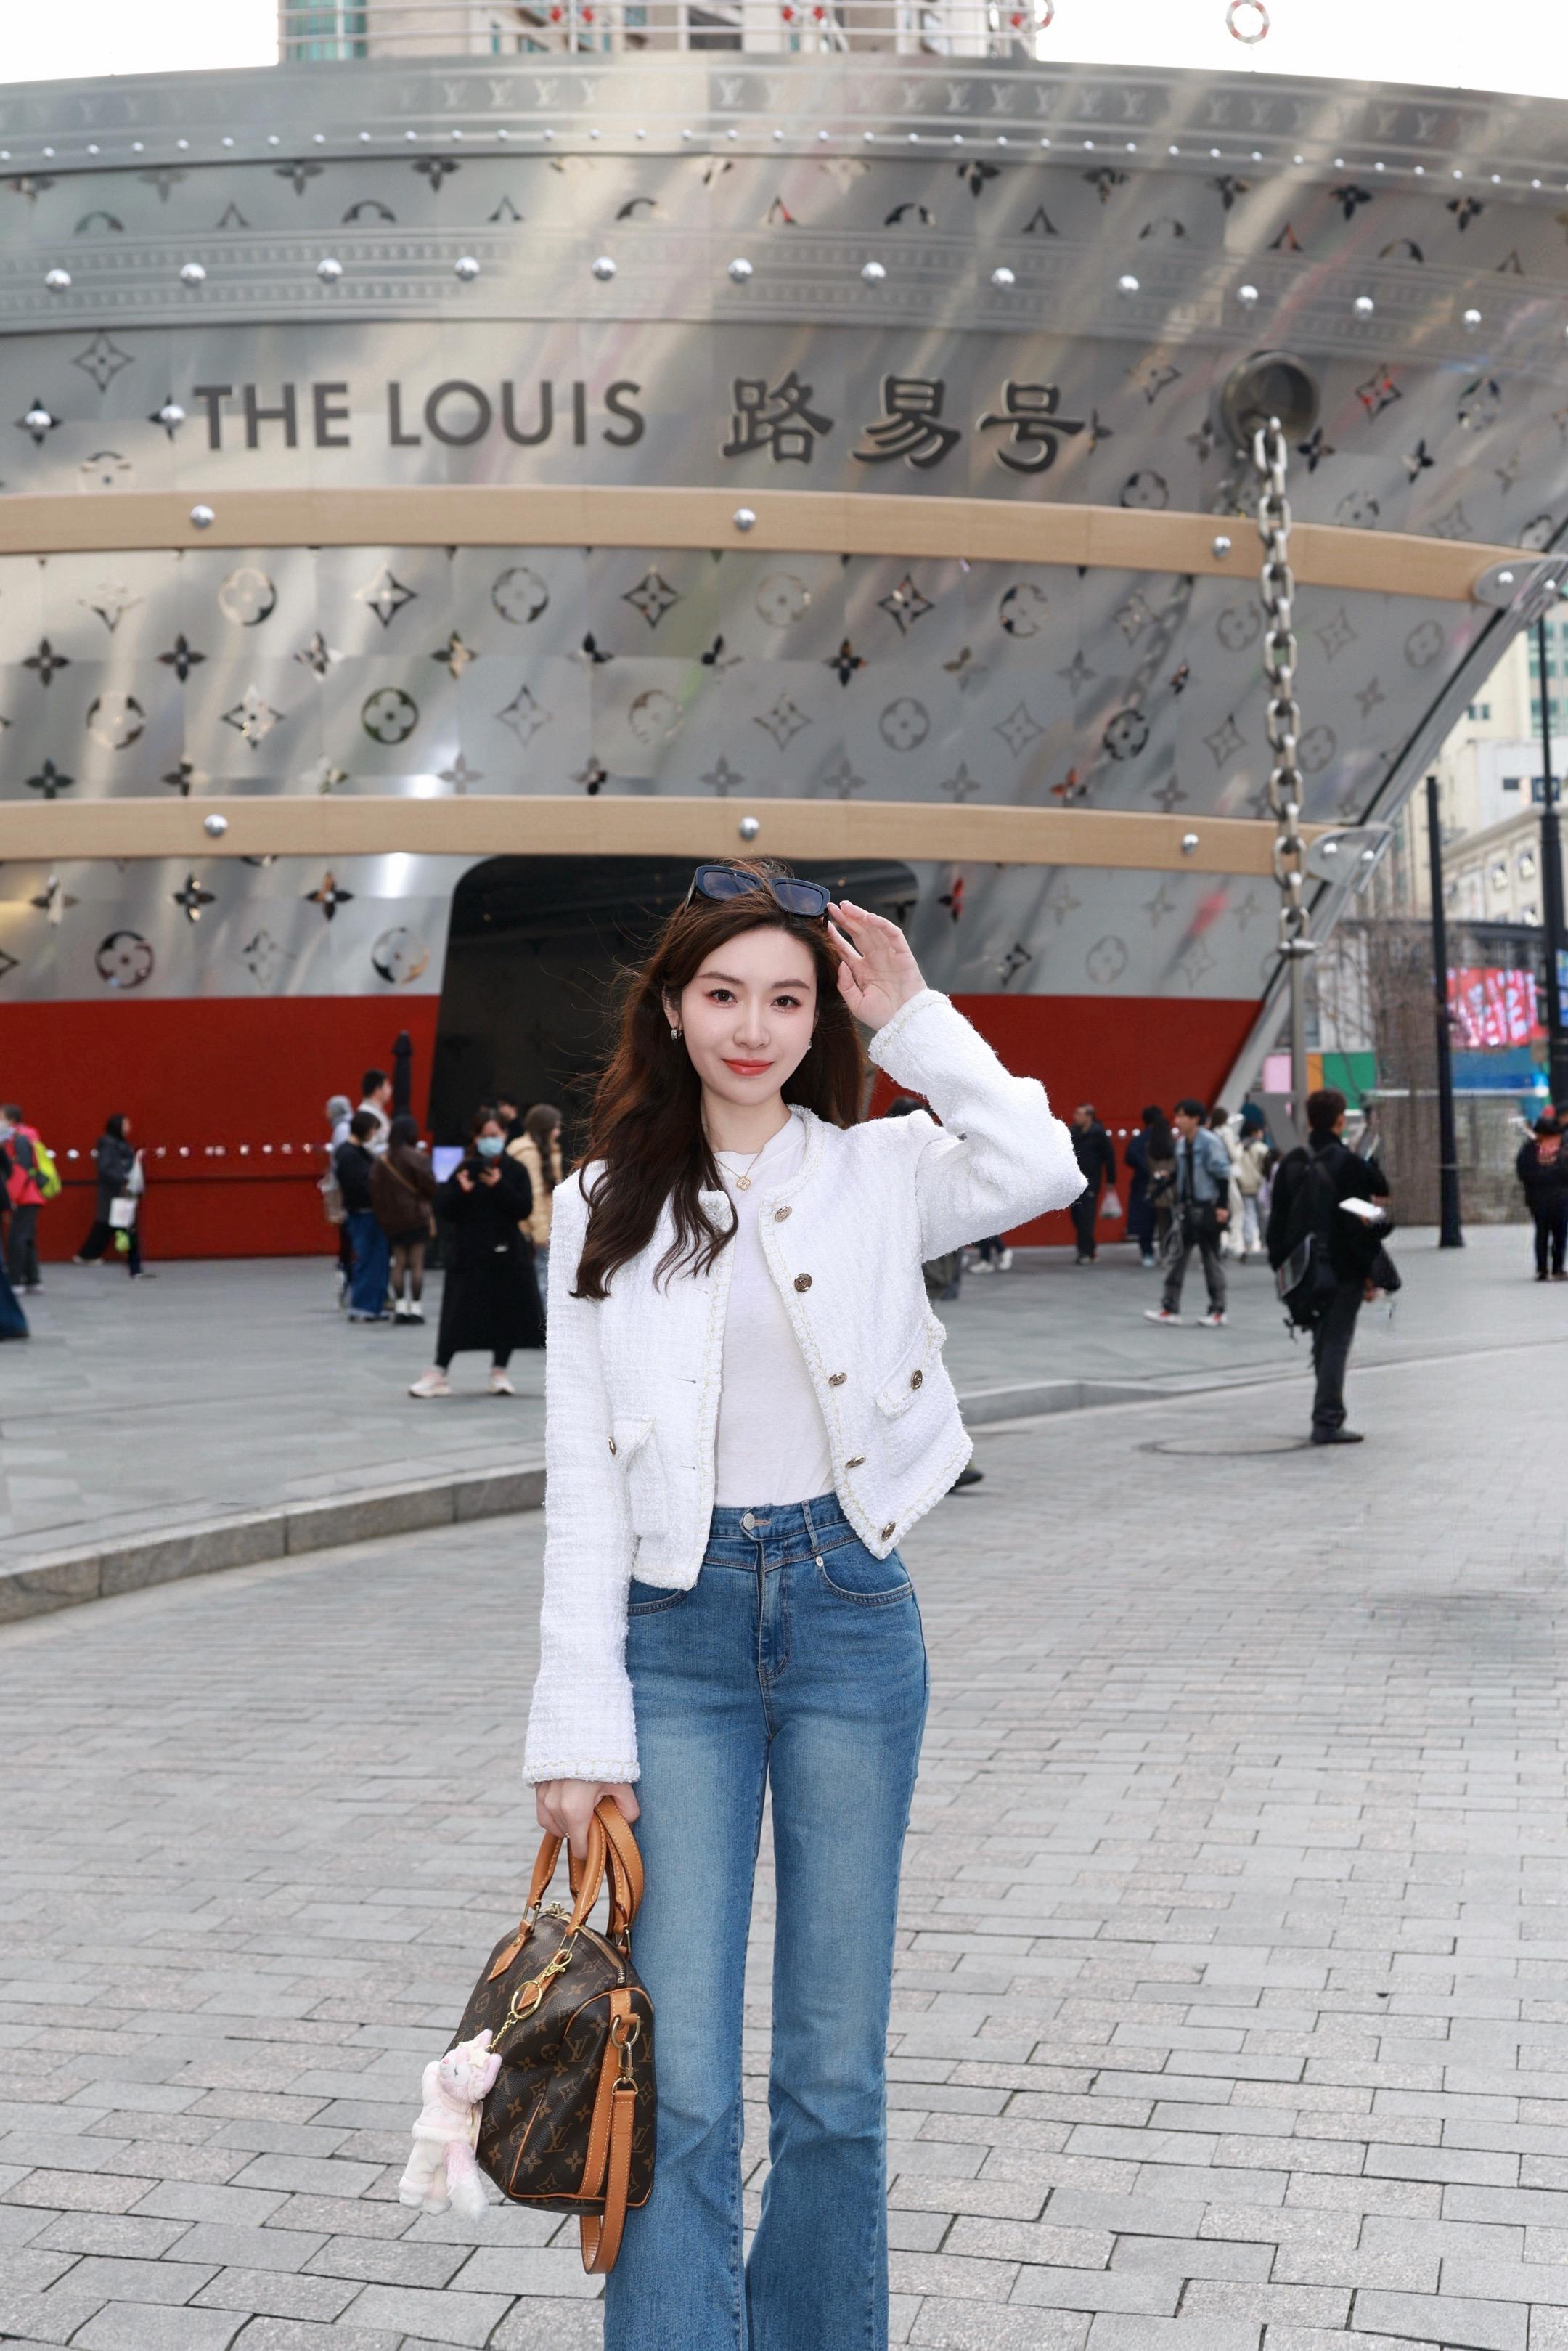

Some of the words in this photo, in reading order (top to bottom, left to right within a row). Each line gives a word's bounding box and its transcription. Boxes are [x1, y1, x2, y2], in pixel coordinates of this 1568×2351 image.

[192, 382, 351, 450] THE
[388, 379, 645, 447] LOUIS
[720, 370, 1085, 474] 路易号
